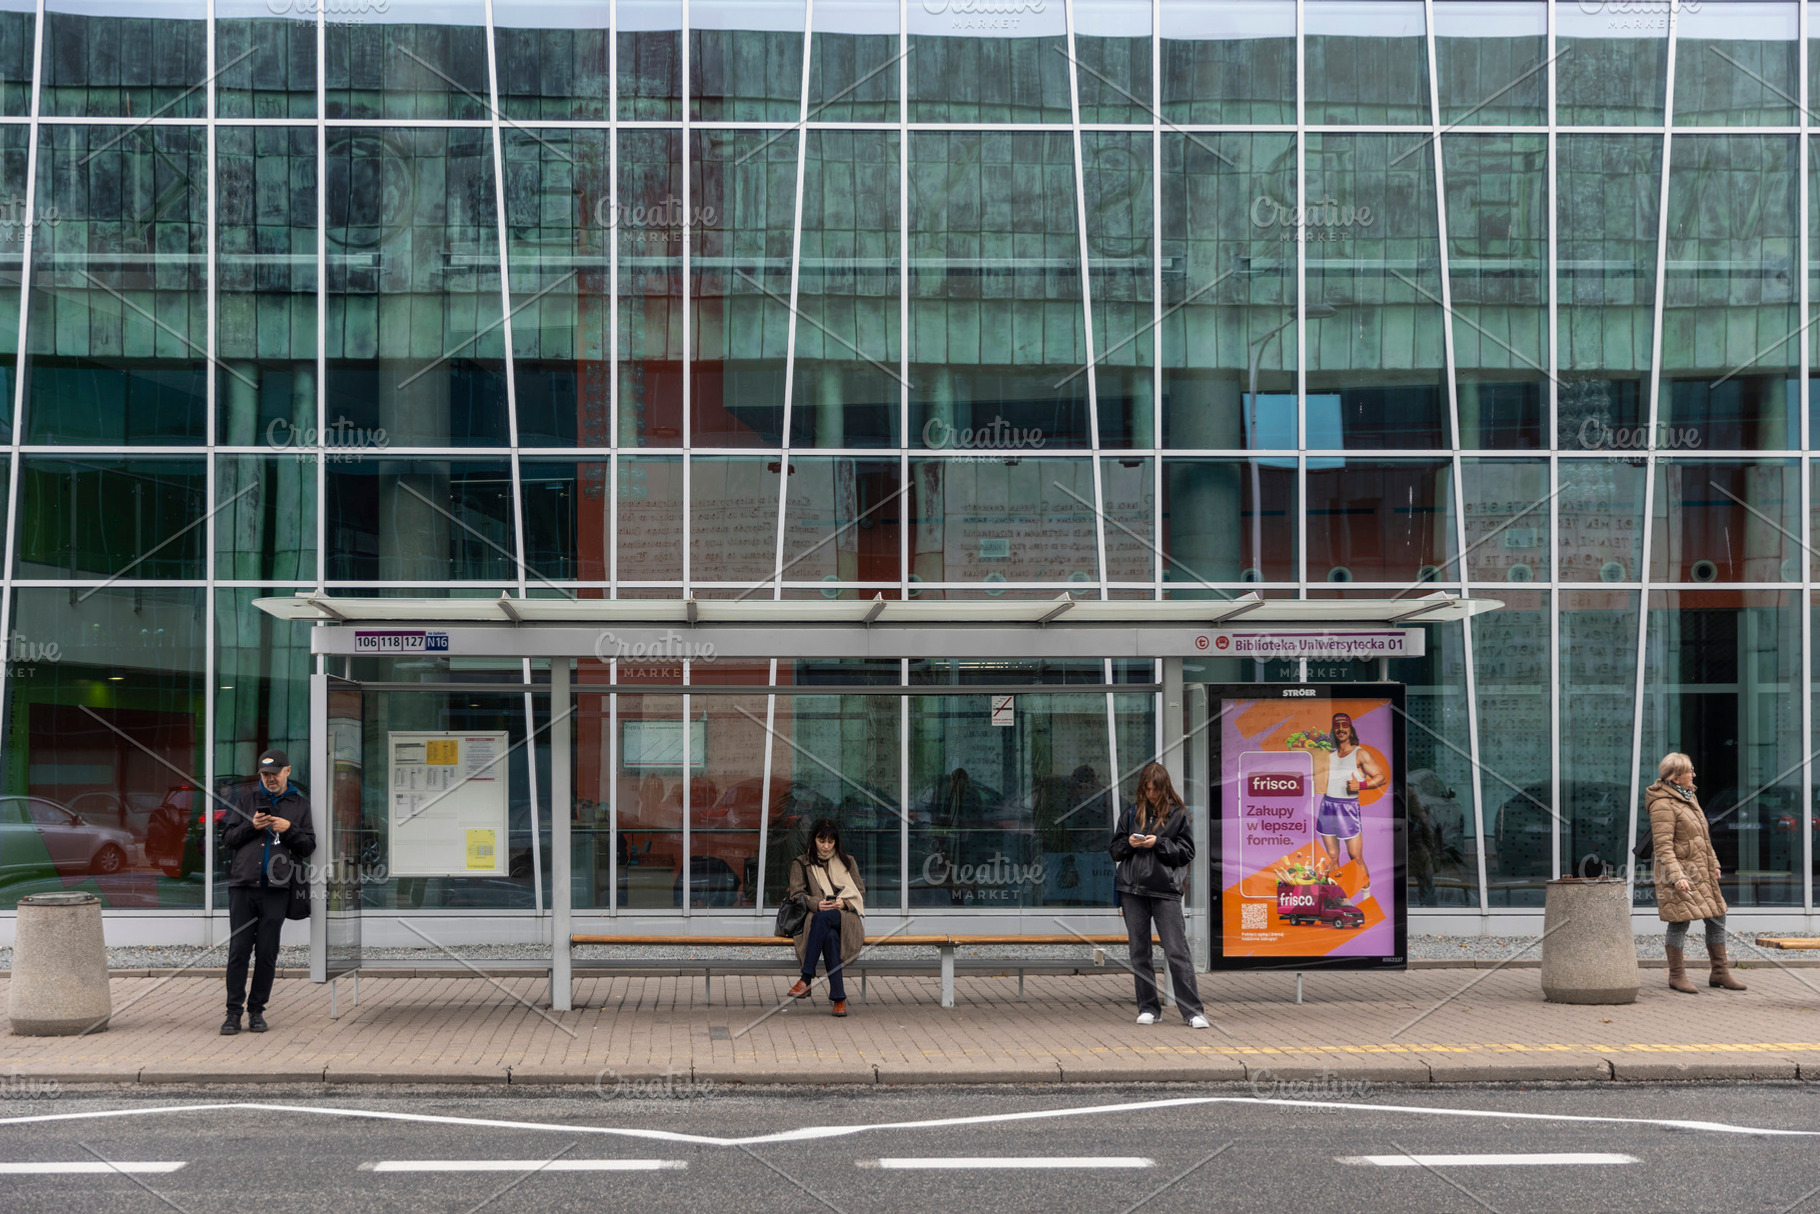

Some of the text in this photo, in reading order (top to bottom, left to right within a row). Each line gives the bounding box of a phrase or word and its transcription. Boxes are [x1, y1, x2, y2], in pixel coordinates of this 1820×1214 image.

[358, 637, 448, 647] 106 118 127 N16
[1236, 638, 1403, 652] Biblioteka Uniwersytecka 01
[1252, 777, 1300, 790] frisco.
[1246, 804, 1294, 819] Zakupy
[1246, 819, 1307, 834] w lepszej
[1246, 834, 1294, 846] formie.
[1280, 893, 1315, 907] frisco.
